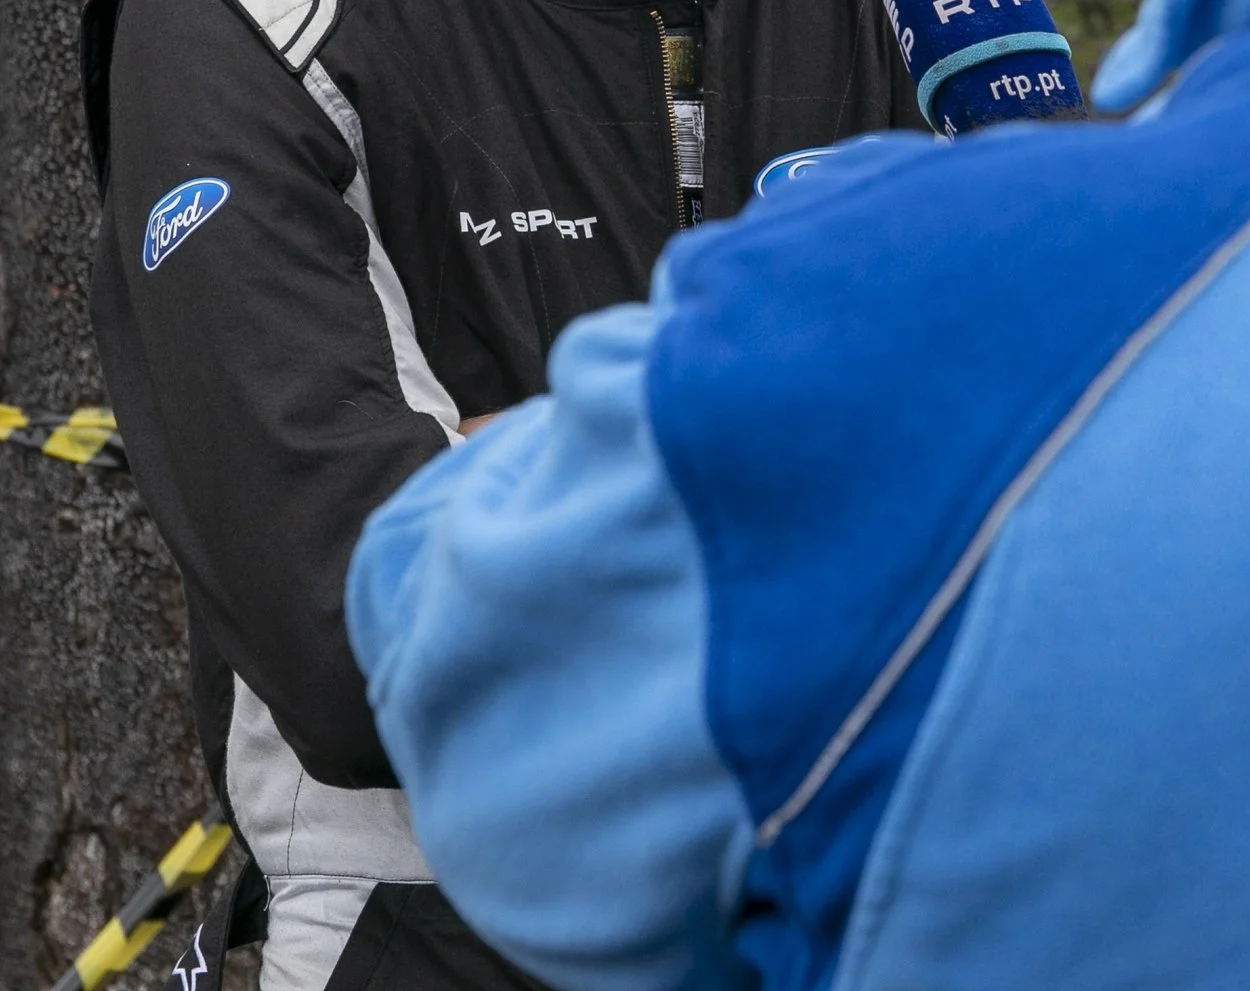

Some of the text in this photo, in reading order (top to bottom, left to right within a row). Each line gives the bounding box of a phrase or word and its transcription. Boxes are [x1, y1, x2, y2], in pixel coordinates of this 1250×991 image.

[989, 69, 1066, 101] rtp.pt
[150, 190, 204, 262] Ford
[511, 209, 598, 239] SPRT
